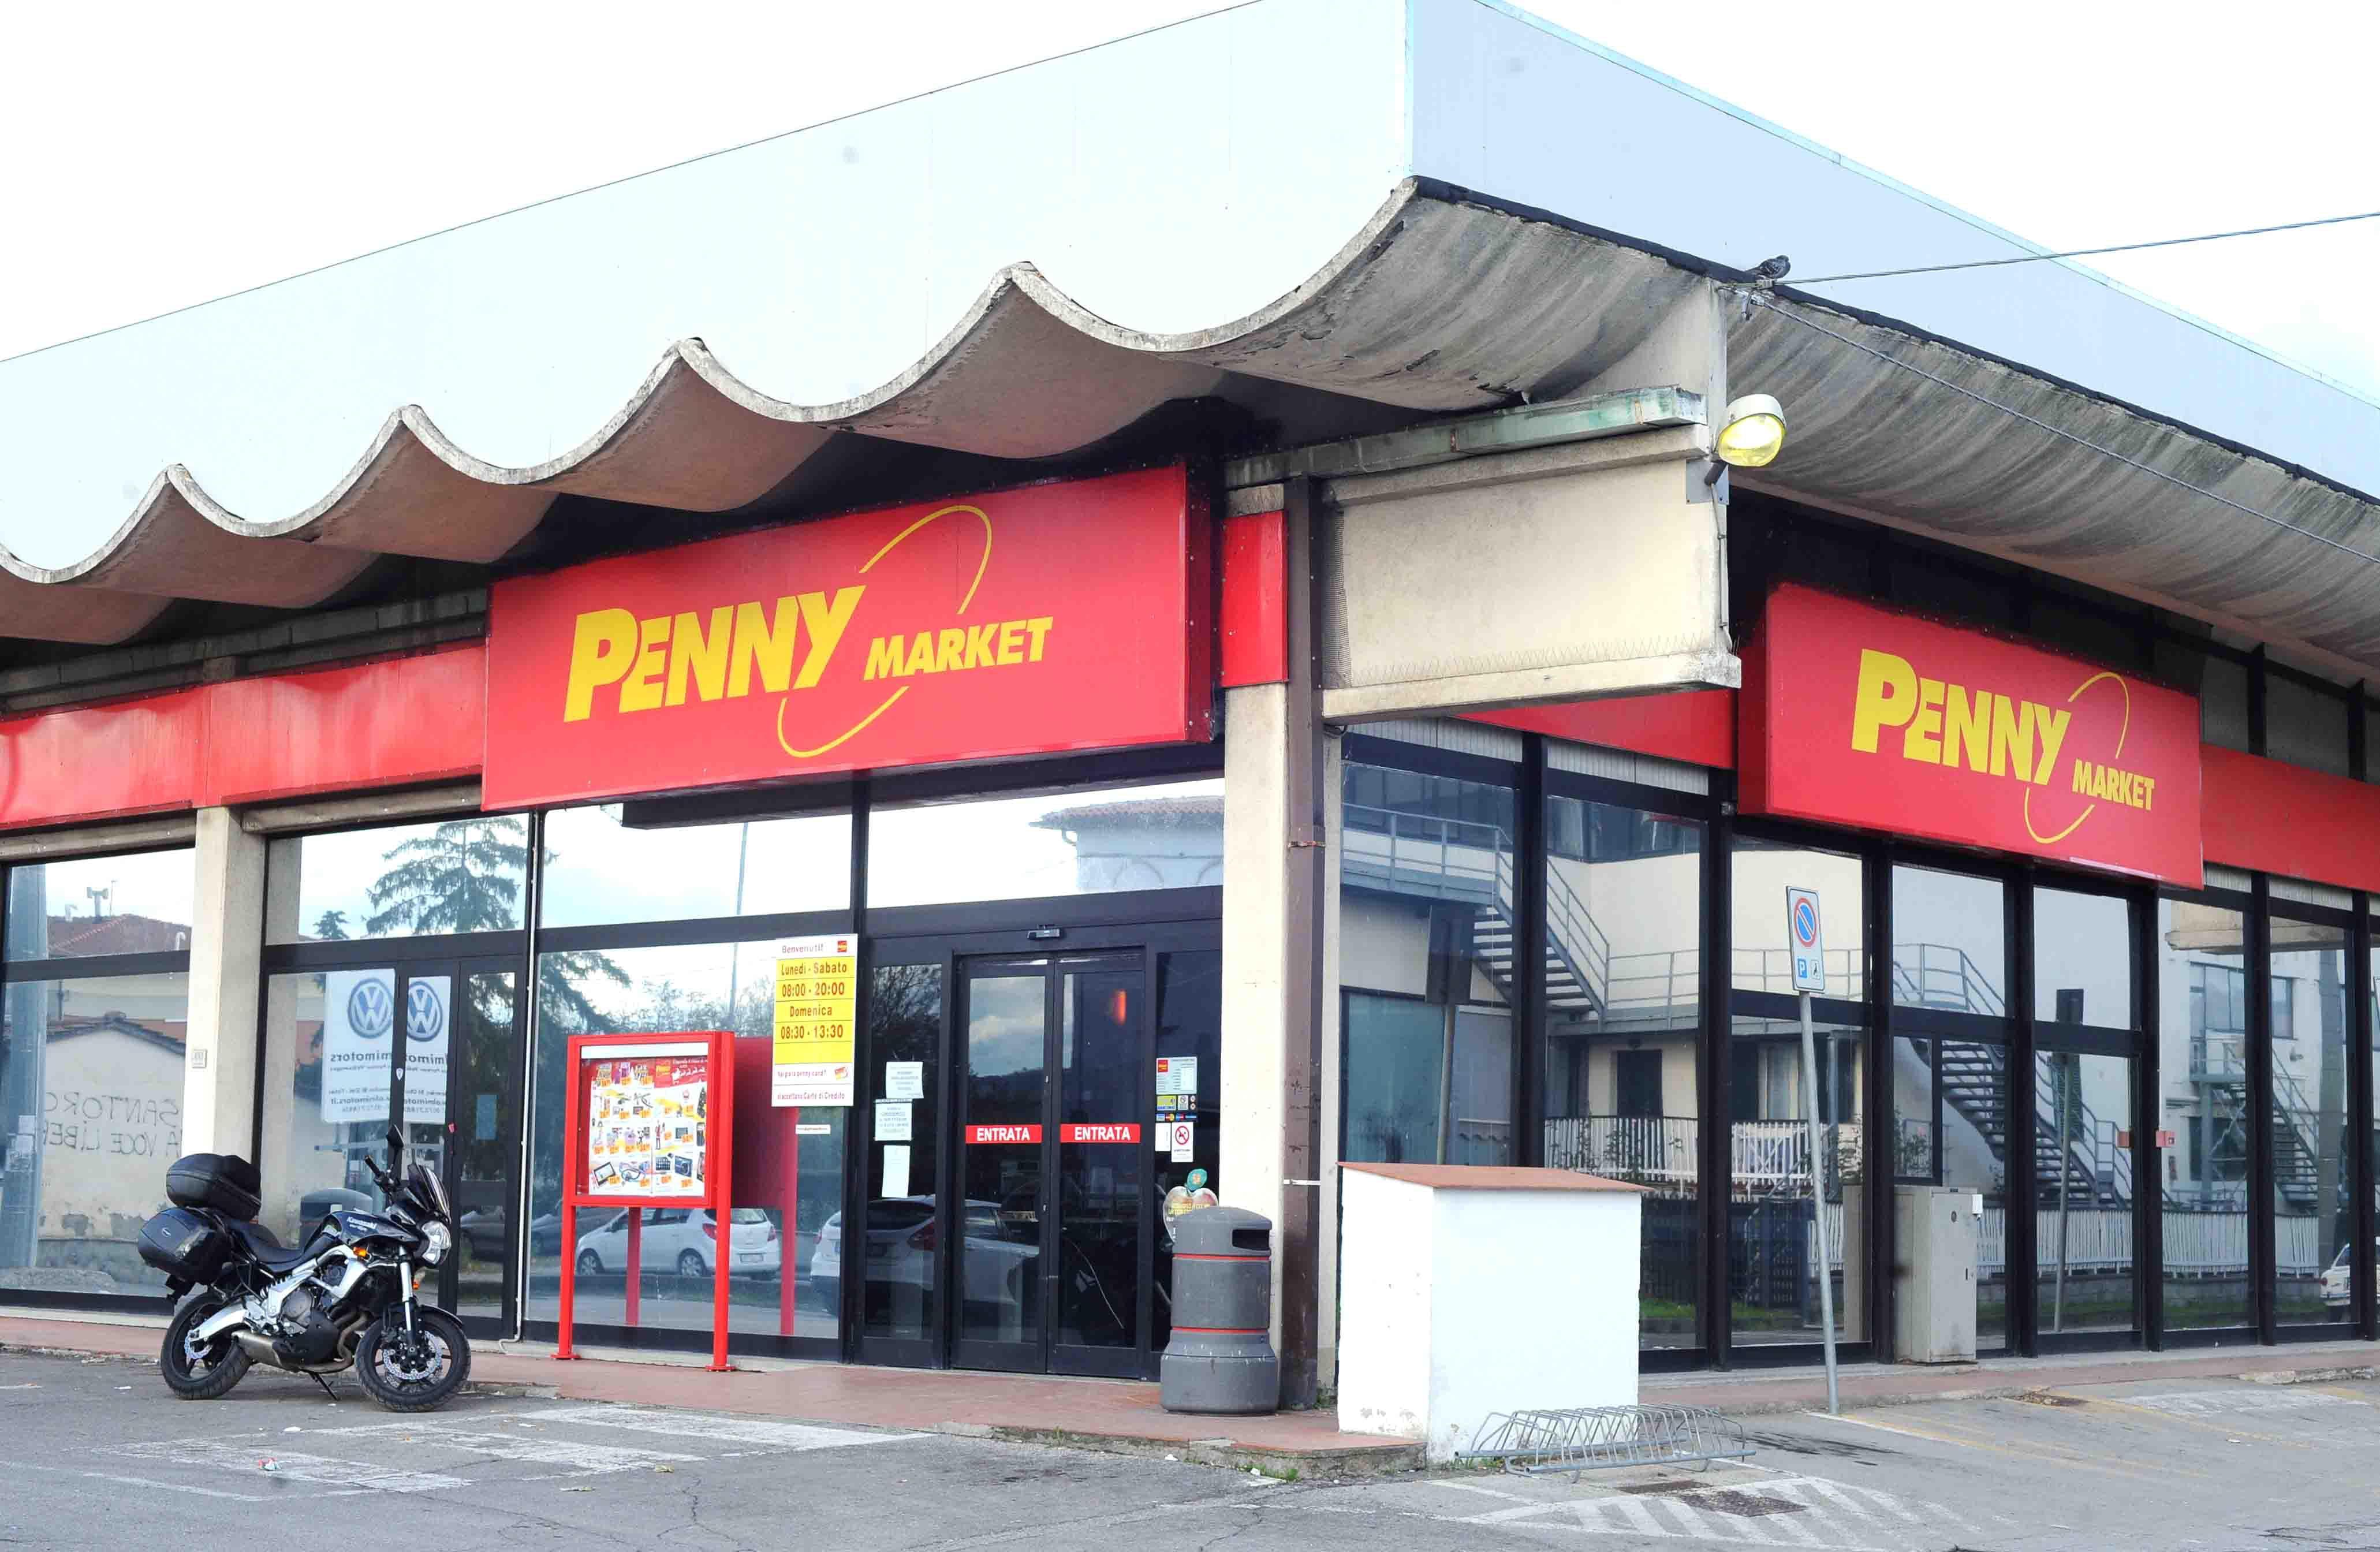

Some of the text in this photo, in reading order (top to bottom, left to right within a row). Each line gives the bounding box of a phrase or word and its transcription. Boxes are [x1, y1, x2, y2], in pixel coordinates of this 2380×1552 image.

[564, 585, 1053, 722] PENNY MARKET
[1852, 648, 2155, 810] PENNY MARKET
[814, 961, 847, 973] Sabato
[782, 983, 805, 997] 08:00
[815, 982, 845, 995] 20:00
[790, 1004, 832, 1017] Domenica
[781, 1025, 804, 1039] 08:30
[814, 1025, 843, 1038] 13:30
[976, 1127, 1030, 1141] ENTRATA
[1074, 1126, 1131, 1140] ENTRATA
